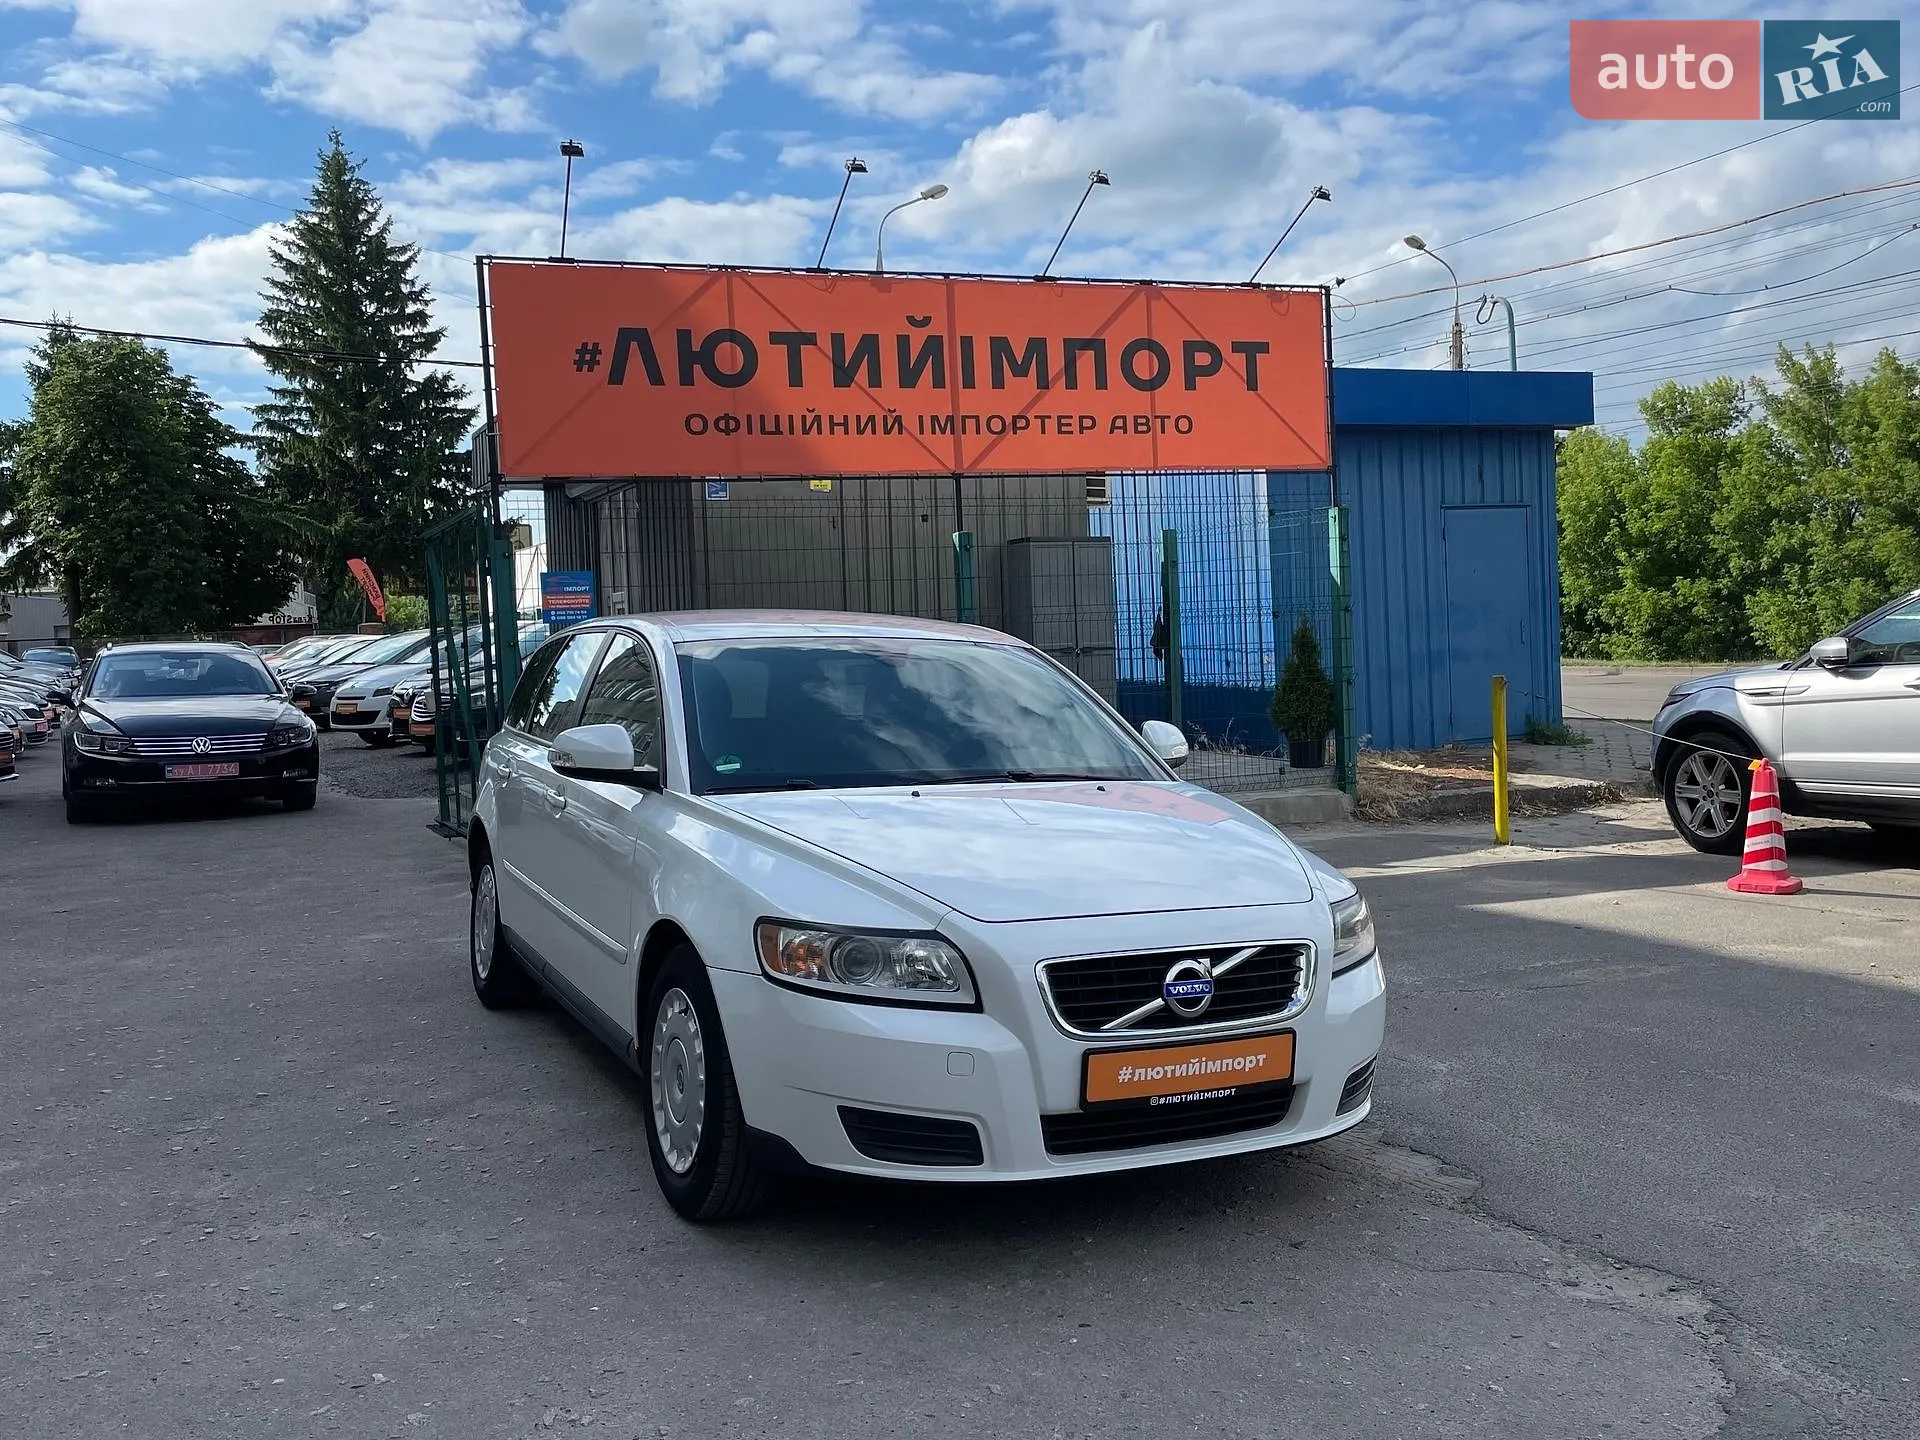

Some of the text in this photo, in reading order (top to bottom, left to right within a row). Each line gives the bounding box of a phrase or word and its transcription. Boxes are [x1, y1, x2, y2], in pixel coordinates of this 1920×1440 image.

[573, 315, 1270, 393] #ЛЮТИЙІМПОРТ
[684, 407, 1195, 436] ОФІЦІЙНИЙ ІМПОРТЕР АВТО
[1168, 982, 1211, 995] VOLVO
[1117, 1053, 1267, 1084] #лютийімпорт
[1158, 1088, 1237, 1105] #ЛЮТИЙІМПОРТ
